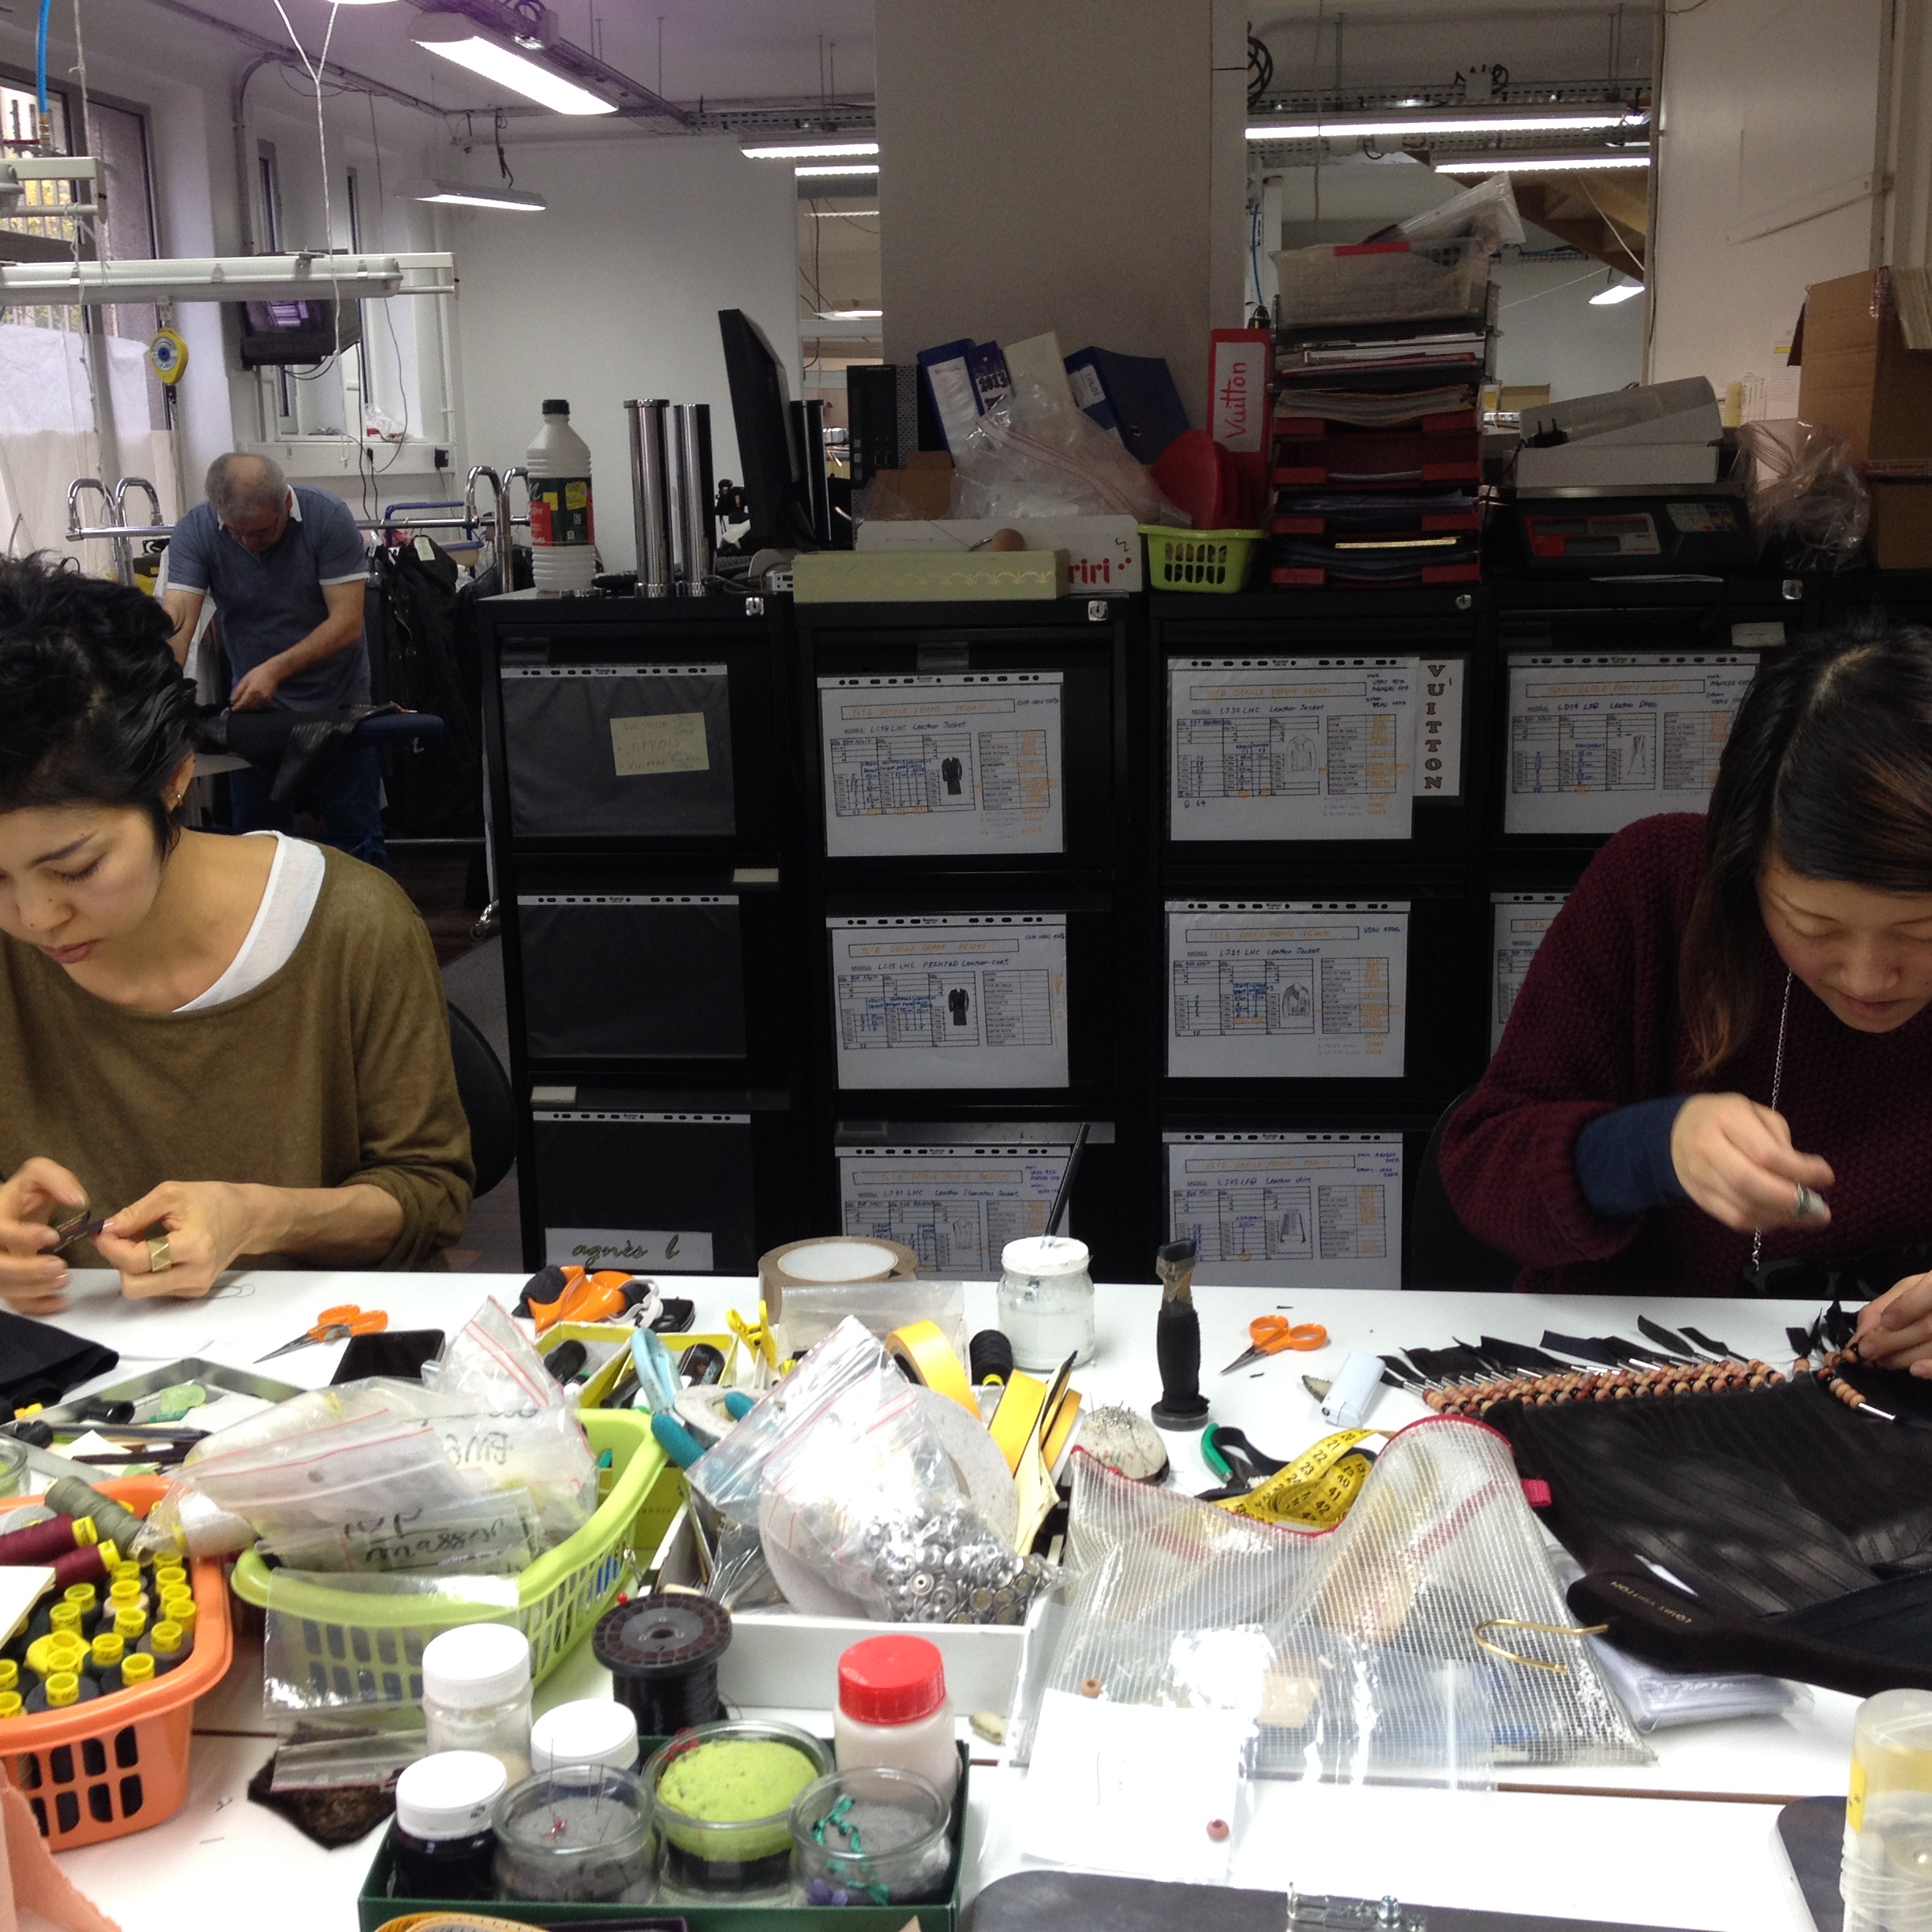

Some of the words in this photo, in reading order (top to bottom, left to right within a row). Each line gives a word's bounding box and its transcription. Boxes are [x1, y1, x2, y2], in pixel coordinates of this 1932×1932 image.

[978, 371, 1008, 392] 2013
[1220, 361, 1247, 439] Vuitton
[1068, 557, 1110, 584] riri
[1424, 664, 1447, 790] VUITTON
[665, 1234, 680, 1260] b
[1327, 1439, 1341, 1451] 21
[1312, 1449, 1327, 1464] 22
[1299, 1462, 1315, 1475] 23
[1337, 1474, 1350, 1488] 40
[1328, 1486, 1342, 1501] 41
[1315, 1500, 1331, 1515] 42
